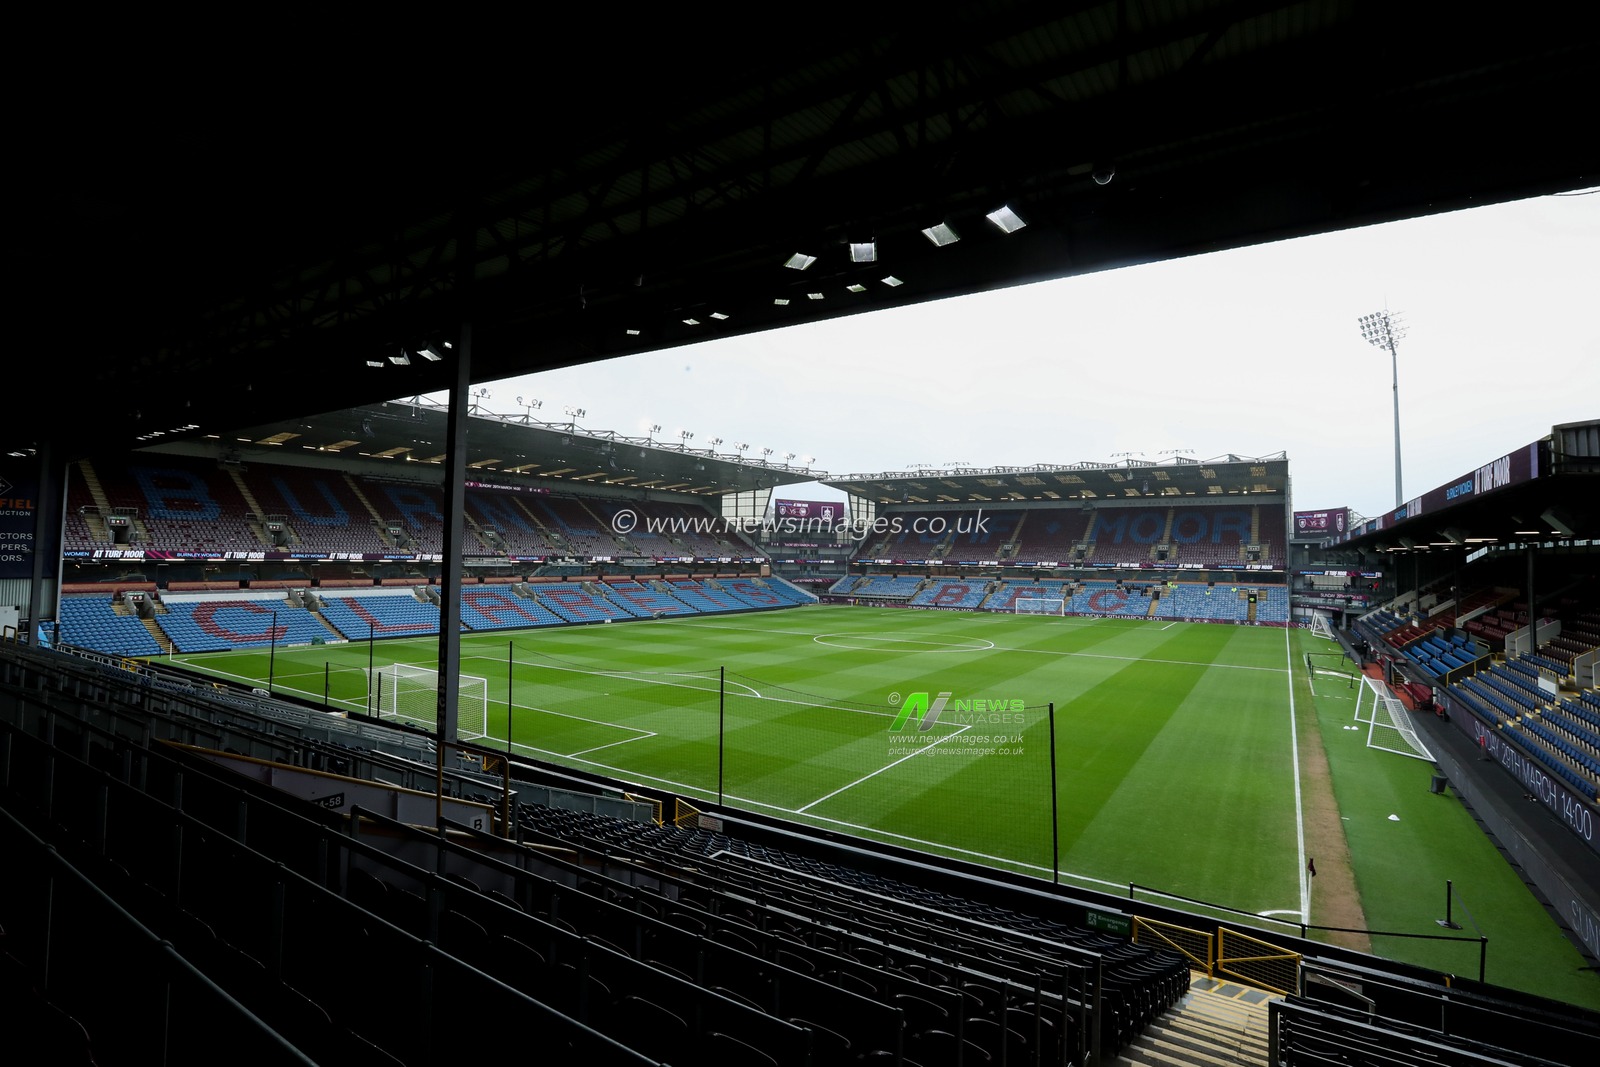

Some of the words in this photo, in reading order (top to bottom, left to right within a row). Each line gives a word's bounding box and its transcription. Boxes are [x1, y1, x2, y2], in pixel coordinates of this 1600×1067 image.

[1481, 463, 1493, 493] TURF
[1494, 456, 1510, 488] MOOR
[93, 550, 104, 558] AT
[104, 550, 122, 558] TURF
[124, 550, 144, 558] MOOR
[1502, 742, 1520, 778] 29TH
[1522, 758, 1556, 810] MARCH
[1562, 791, 1592, 840] 14:00
[1098, 916, 1128, 927] Emergency
[1571, 900, 1600, 956] SUN
